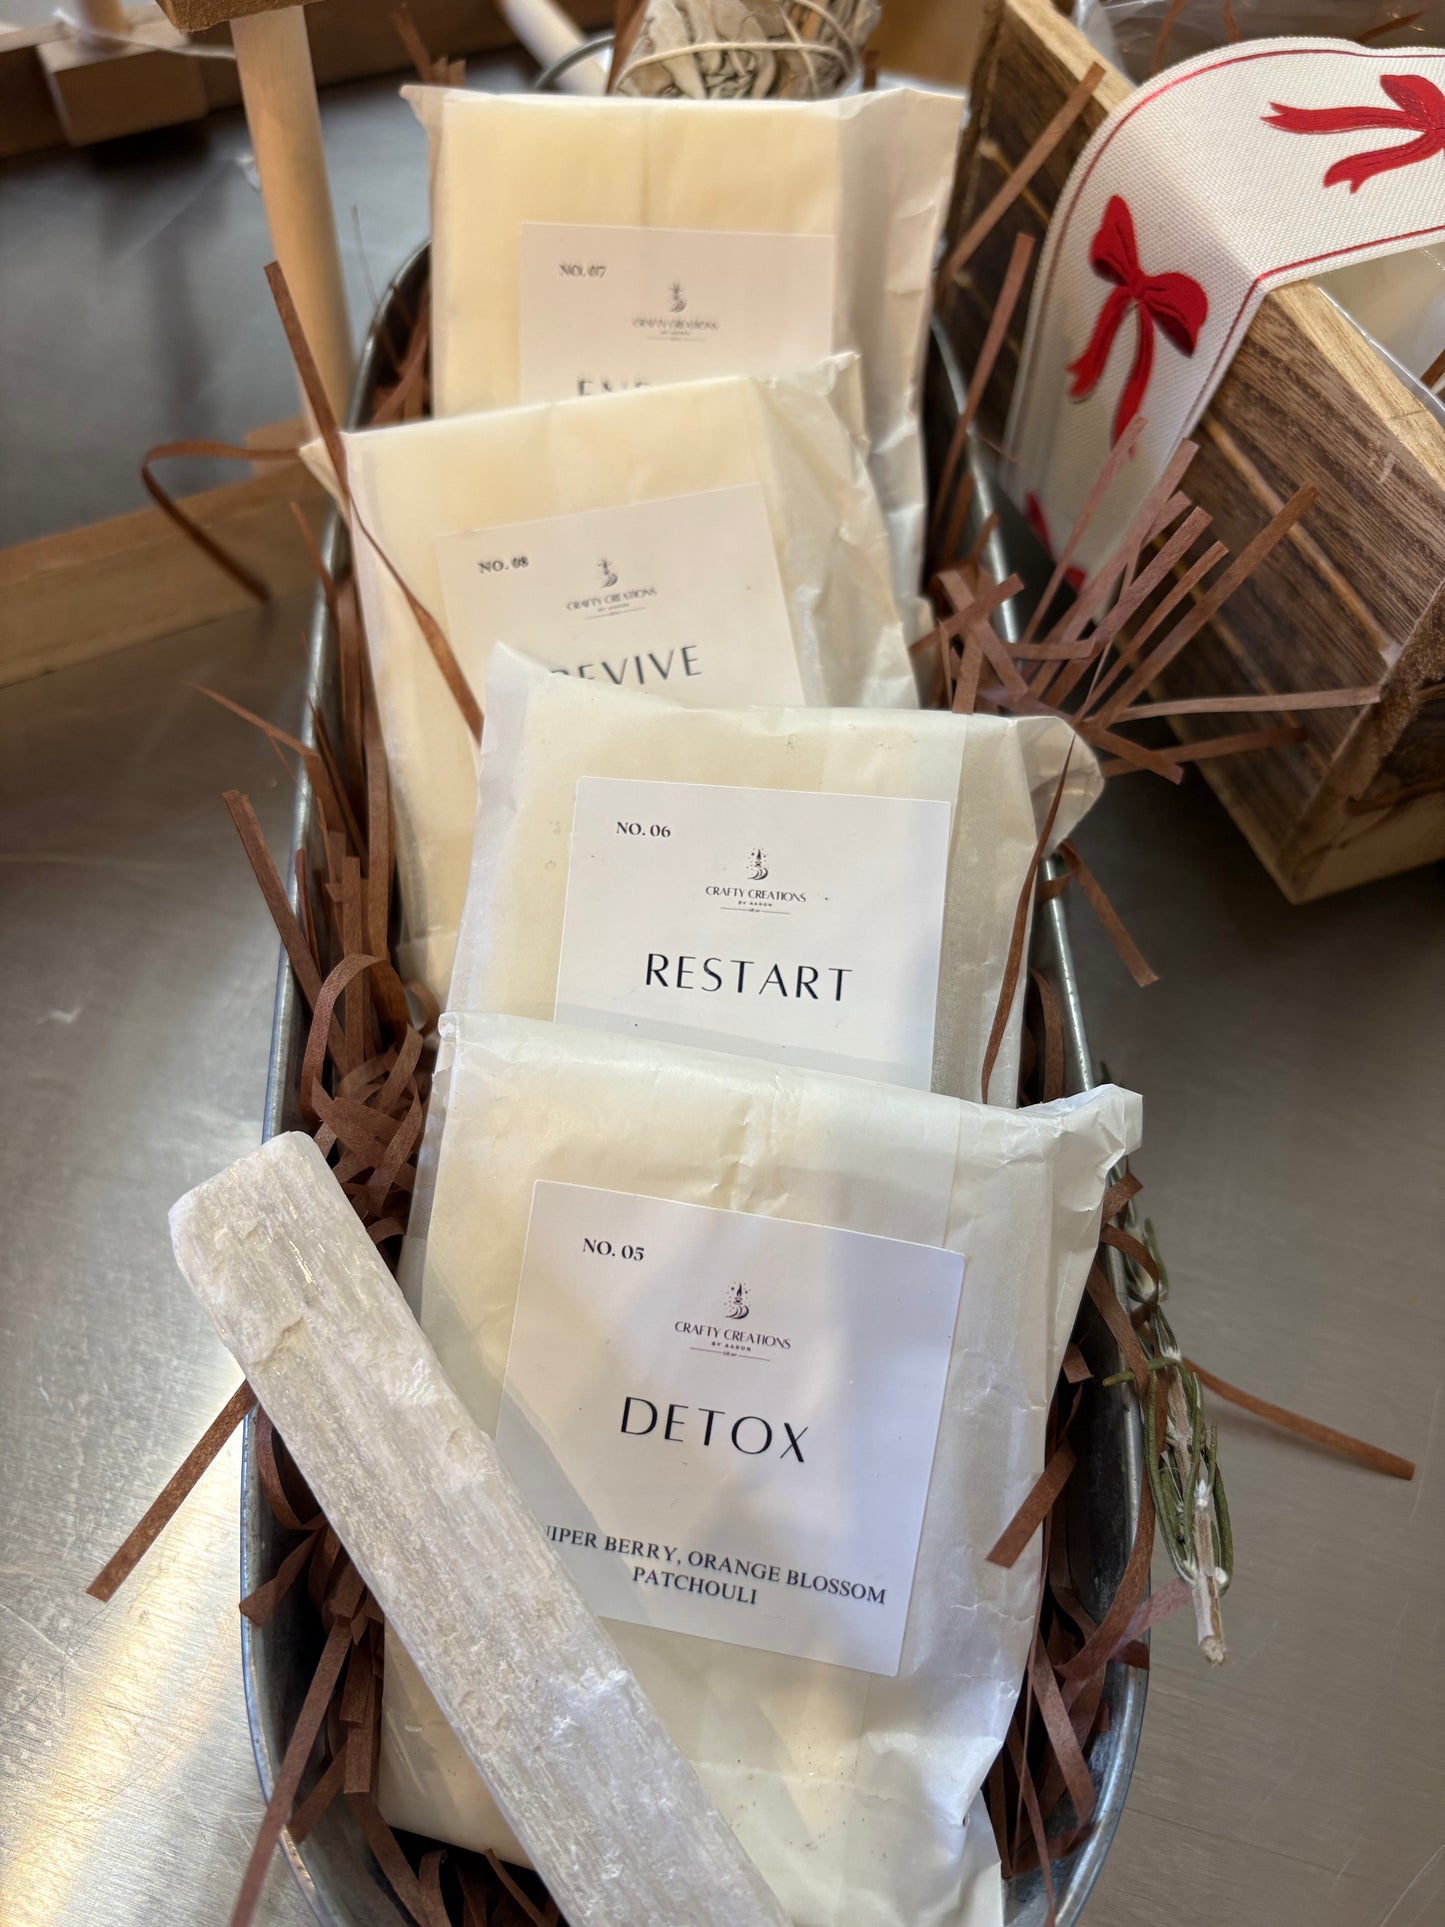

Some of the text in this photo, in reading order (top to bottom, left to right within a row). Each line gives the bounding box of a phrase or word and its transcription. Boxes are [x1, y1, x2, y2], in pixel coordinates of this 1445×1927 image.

[477, 555, 530, 574] NO. 08
[551, 645, 702, 685] EVIVE
[616, 820, 672, 839] NO. 06
[705, 885, 807, 903] CRAFTY CREATIONS
[645, 952, 854, 1002] RESTART
[582, 1237, 645, 1262] NO. 05
[674, 1320, 792, 1350] CRAFTY CREATIONS
[619, 1396, 810, 1463] DETOX
[546, 1524, 888, 1605] IPER BERRY, ORANGE BLOSSOM
[632, 1565, 758, 1605] PATCHOULI
